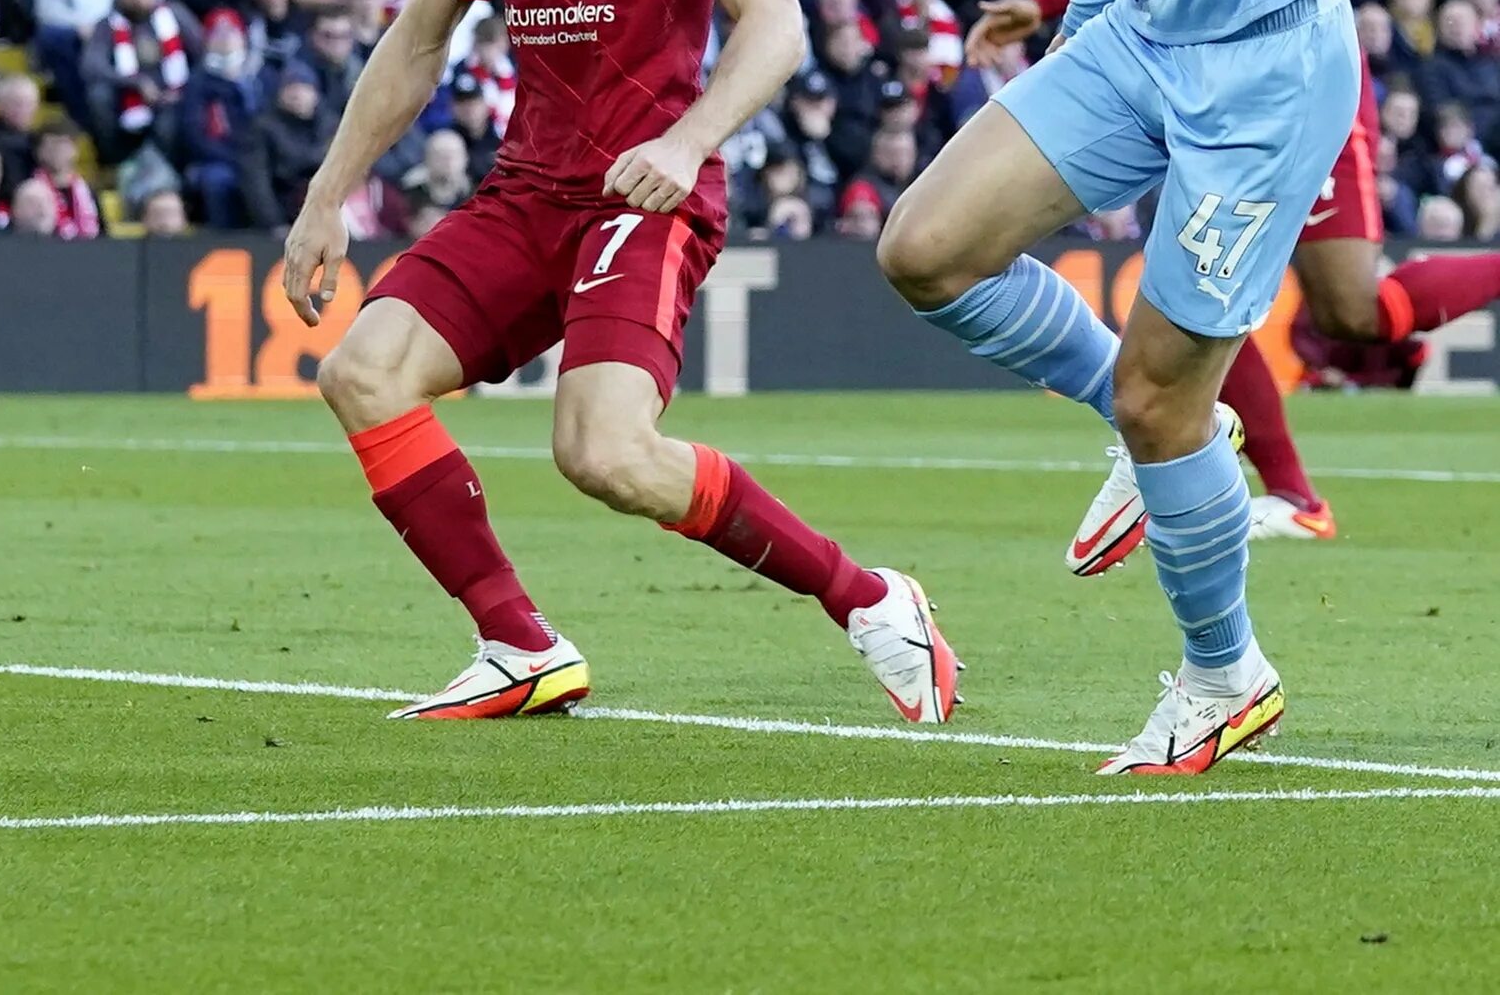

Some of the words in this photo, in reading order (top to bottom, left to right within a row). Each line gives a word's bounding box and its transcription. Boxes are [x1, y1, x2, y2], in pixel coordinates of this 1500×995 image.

[504, 1, 615, 26] uturemakers
[593, 213, 644, 274] 7
[1177, 193, 1277, 280] 47
